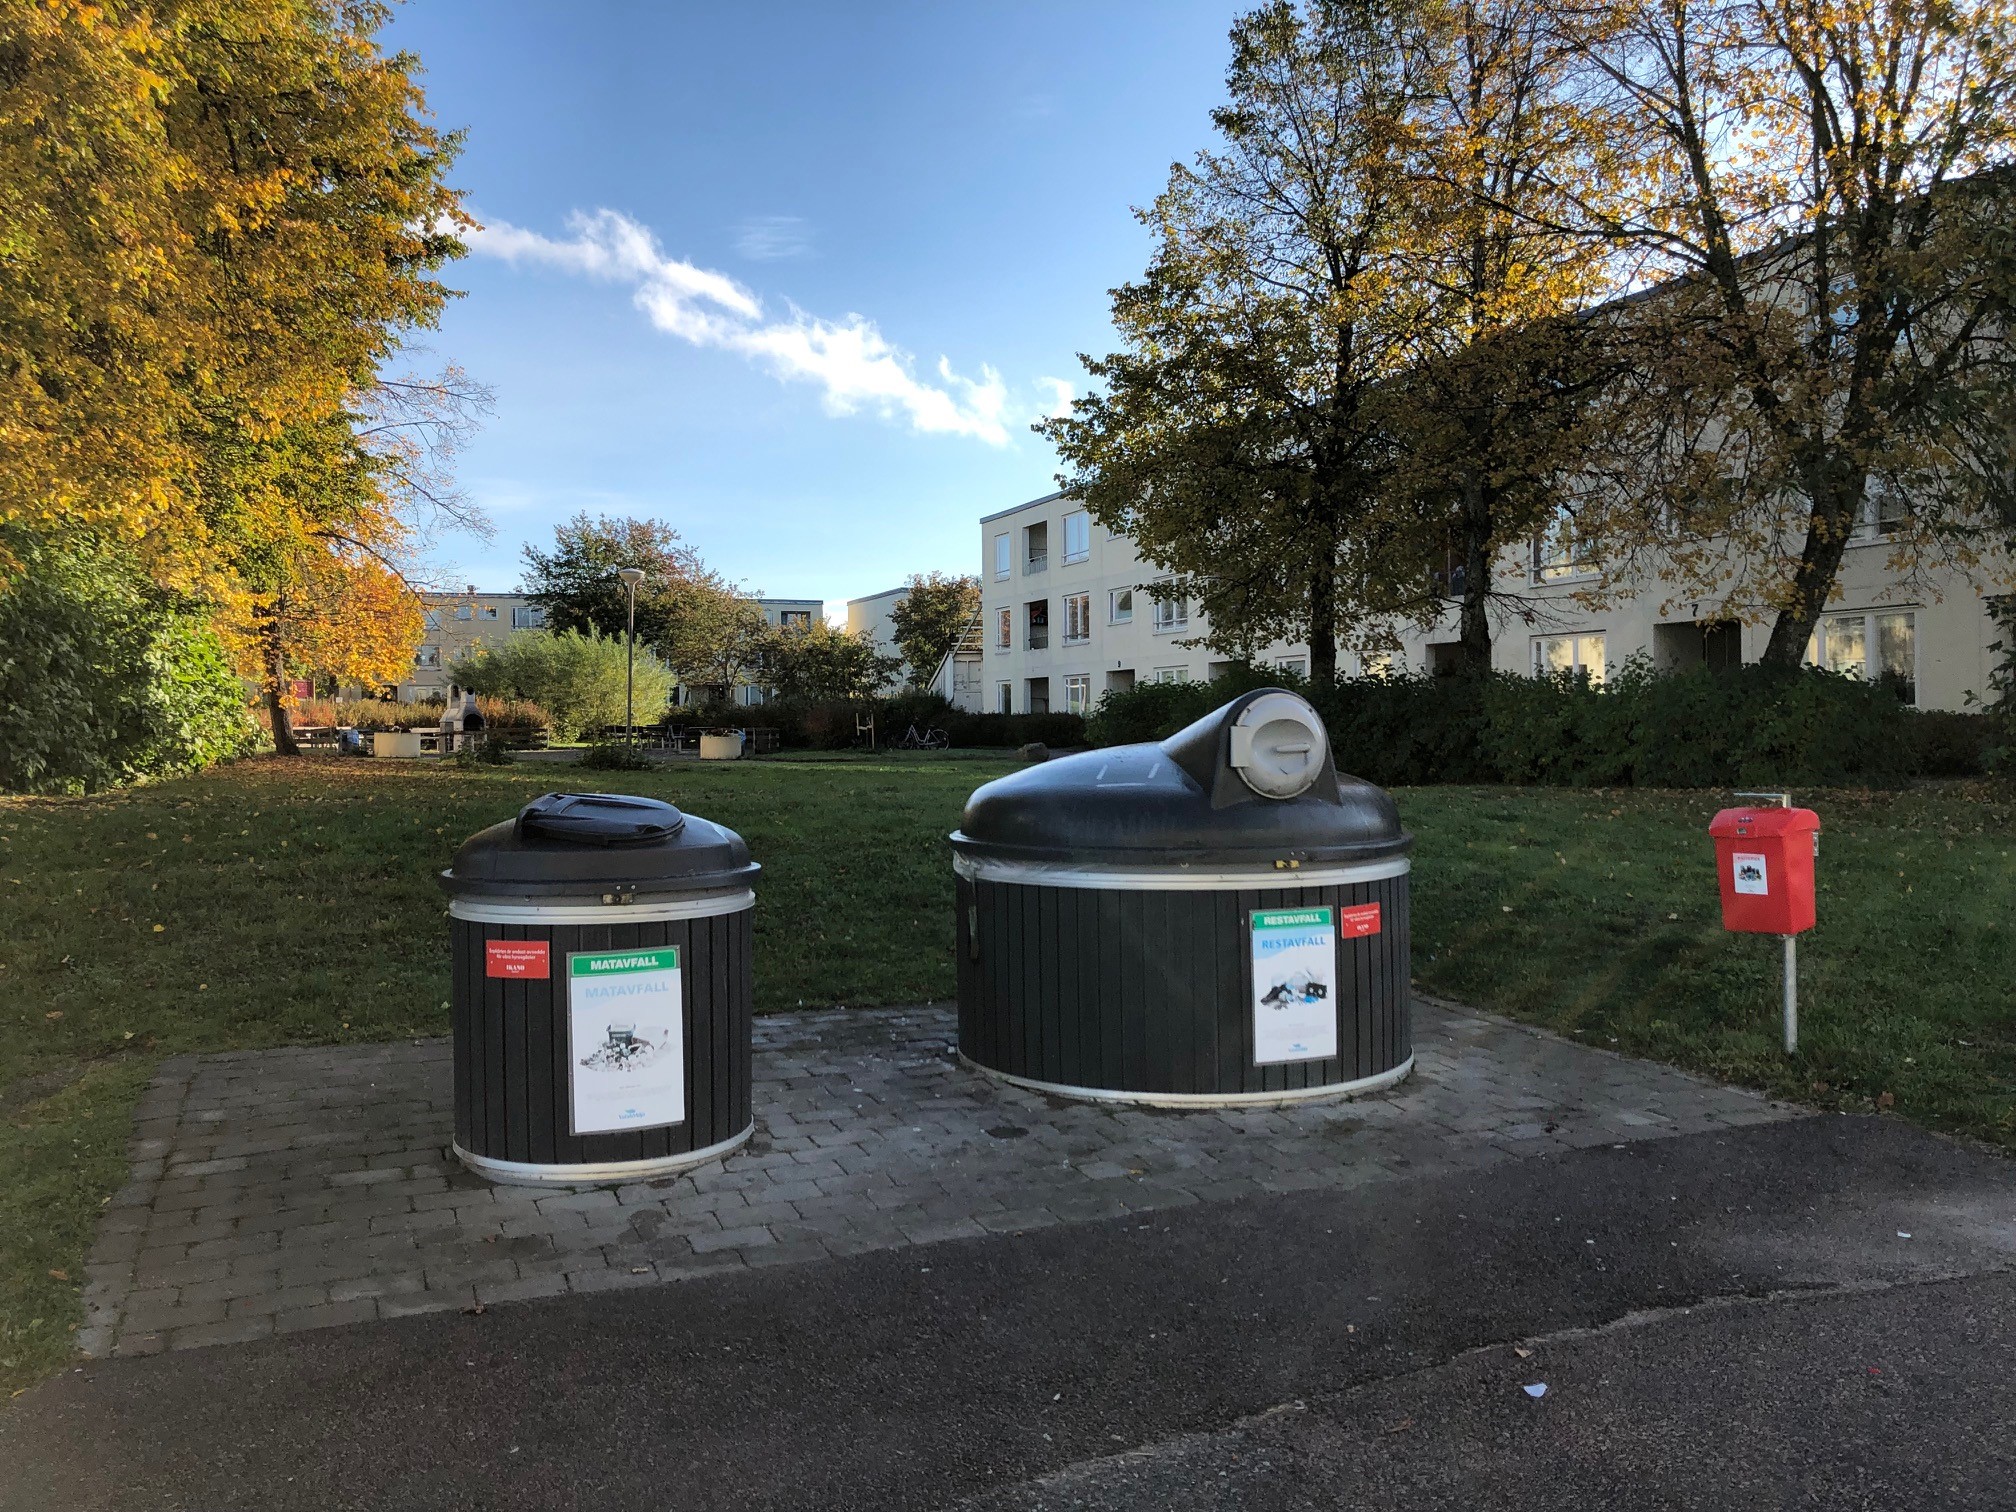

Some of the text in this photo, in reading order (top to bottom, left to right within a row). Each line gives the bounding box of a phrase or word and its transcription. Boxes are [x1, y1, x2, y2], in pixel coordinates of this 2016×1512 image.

[1691, 604, 1699, 617] 7
[1263, 914, 1322, 925] RESTAVFALL
[1262, 936, 1326, 949] RESTAVFALL
[590, 956, 659, 970] MATAVFALL
[585, 981, 669, 998] MATAVFALL
